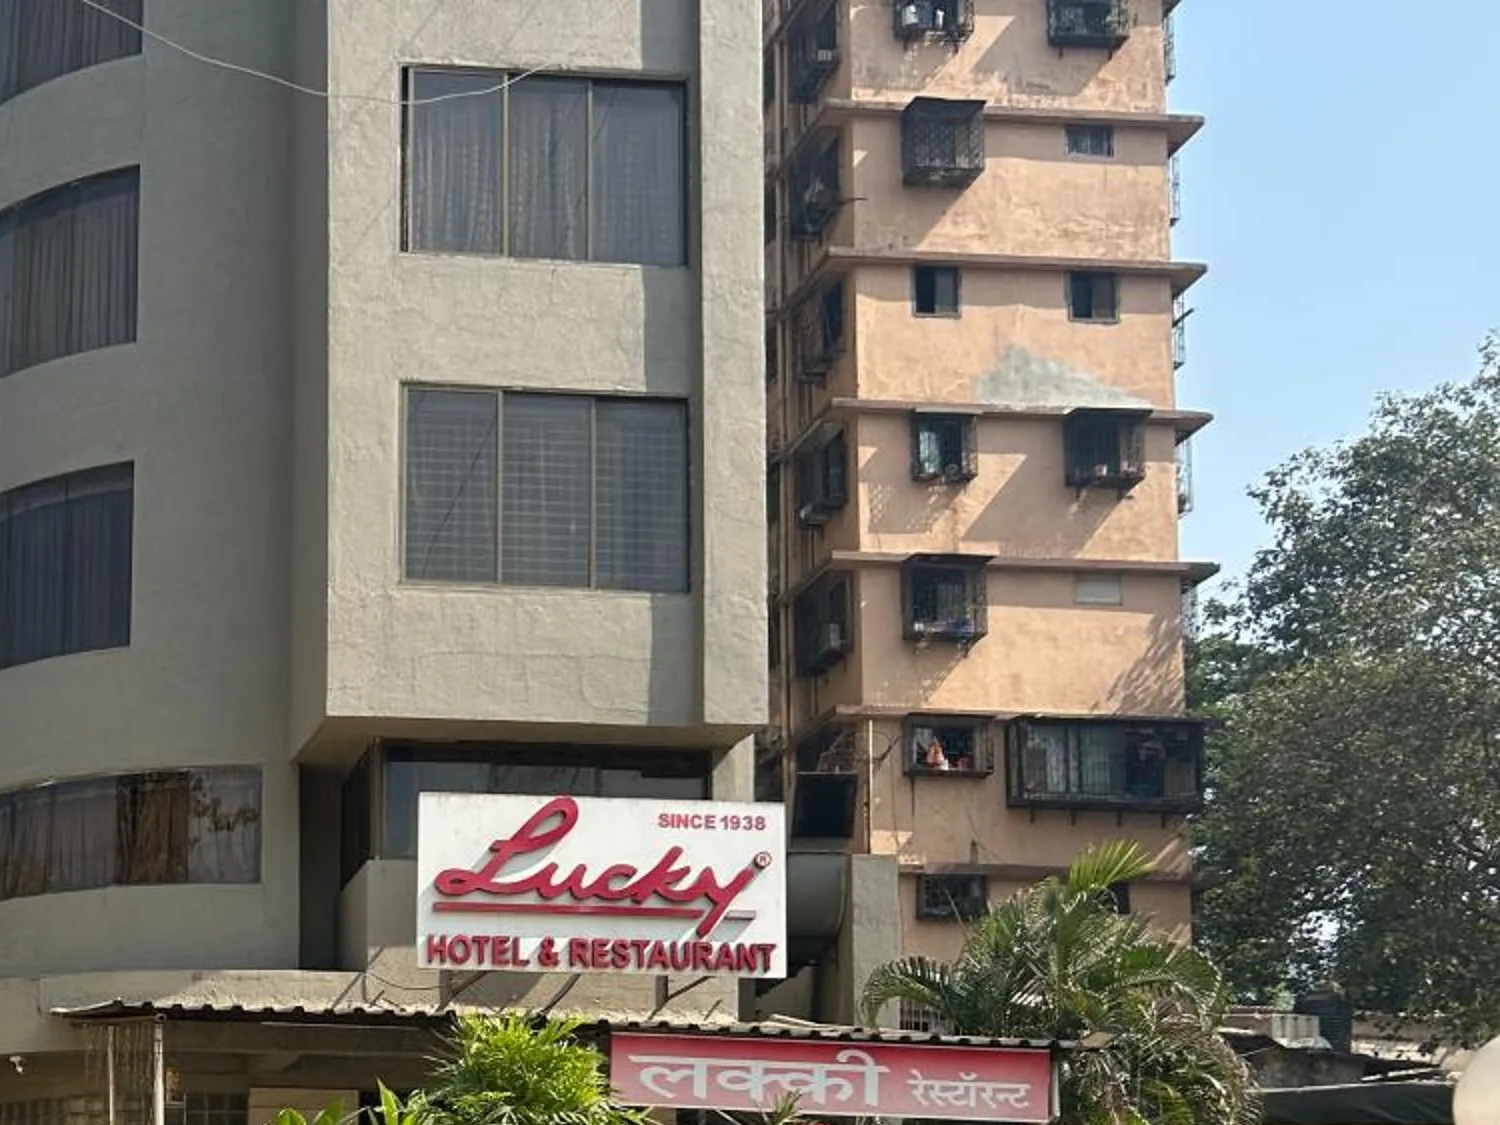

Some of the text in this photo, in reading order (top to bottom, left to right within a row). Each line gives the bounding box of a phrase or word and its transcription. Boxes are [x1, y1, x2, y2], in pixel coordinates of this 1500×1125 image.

[657, 812, 767, 831] SINCE 1938
[433, 795, 758, 937] Lucky
[426, 933, 777, 975] HOTEL & RESTAURANT
[628, 1050, 890, 1106] लक्की
